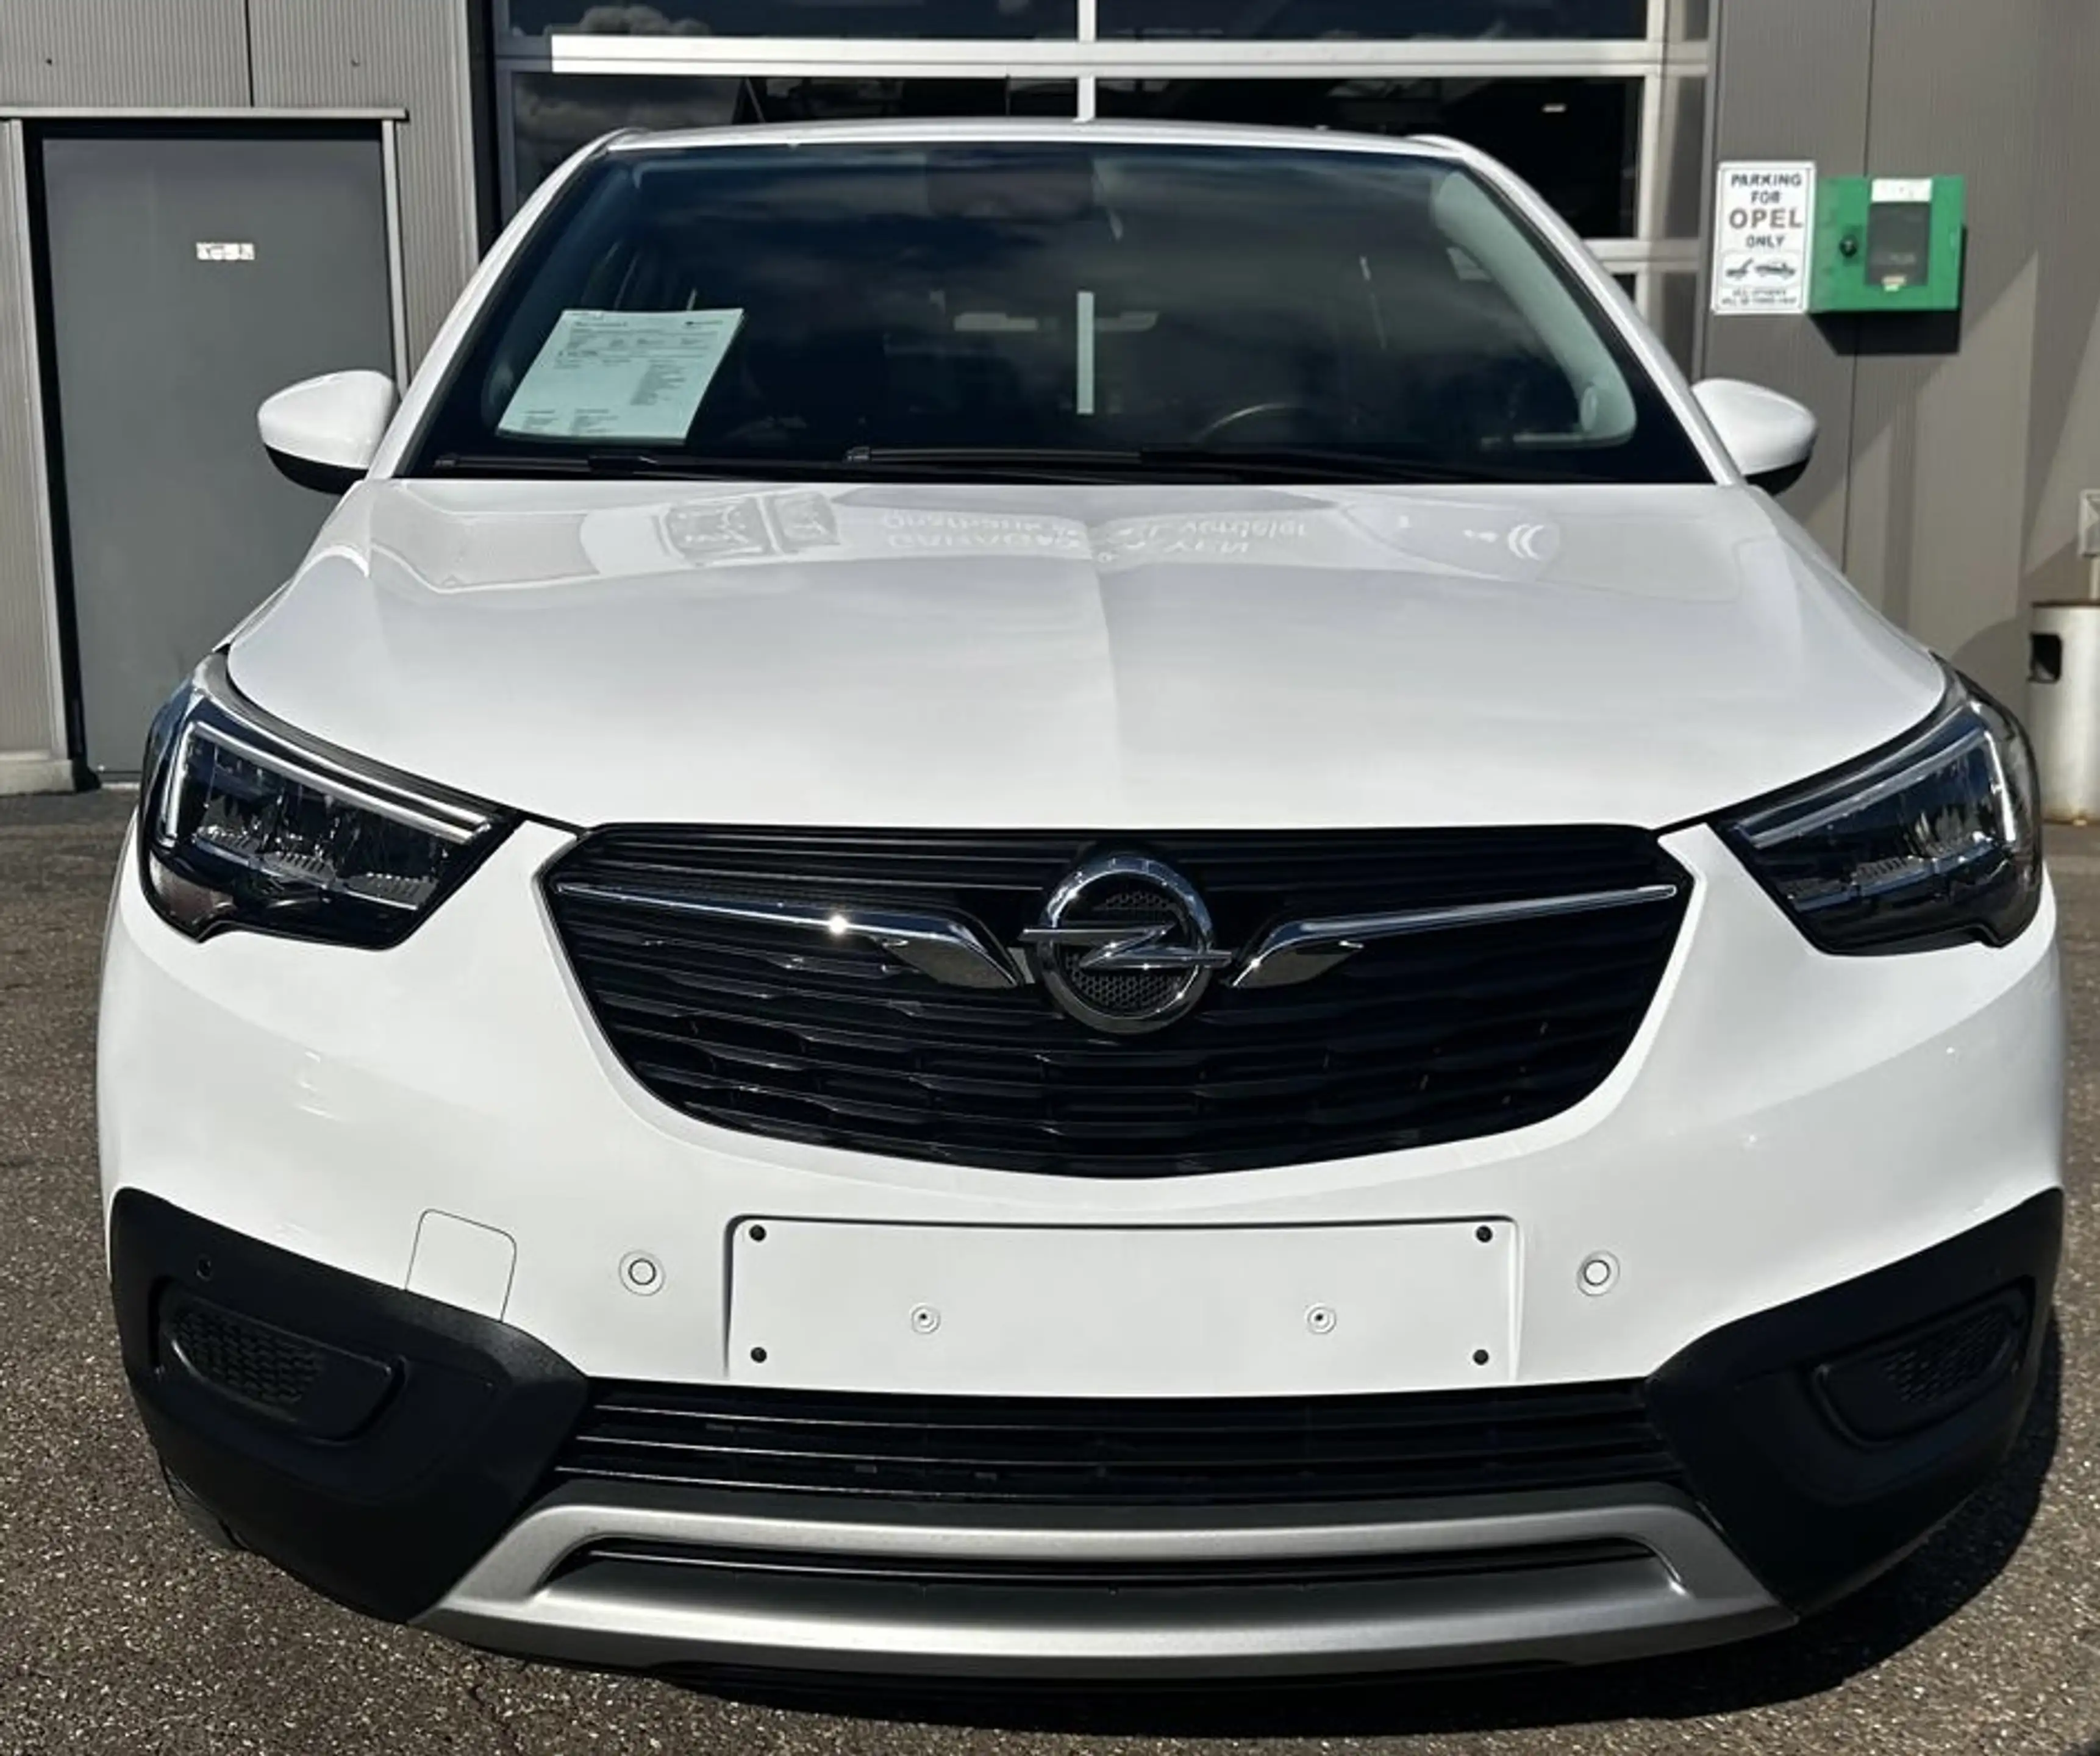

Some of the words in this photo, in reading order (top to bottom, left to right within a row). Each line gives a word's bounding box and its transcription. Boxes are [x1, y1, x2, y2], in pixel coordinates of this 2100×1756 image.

[1731, 174, 1802, 188] PARKING
[1751, 190, 1780, 204] FOR
[1729, 207, 1804, 229] OPEL
[1746, 234, 1786, 249] ONLY
